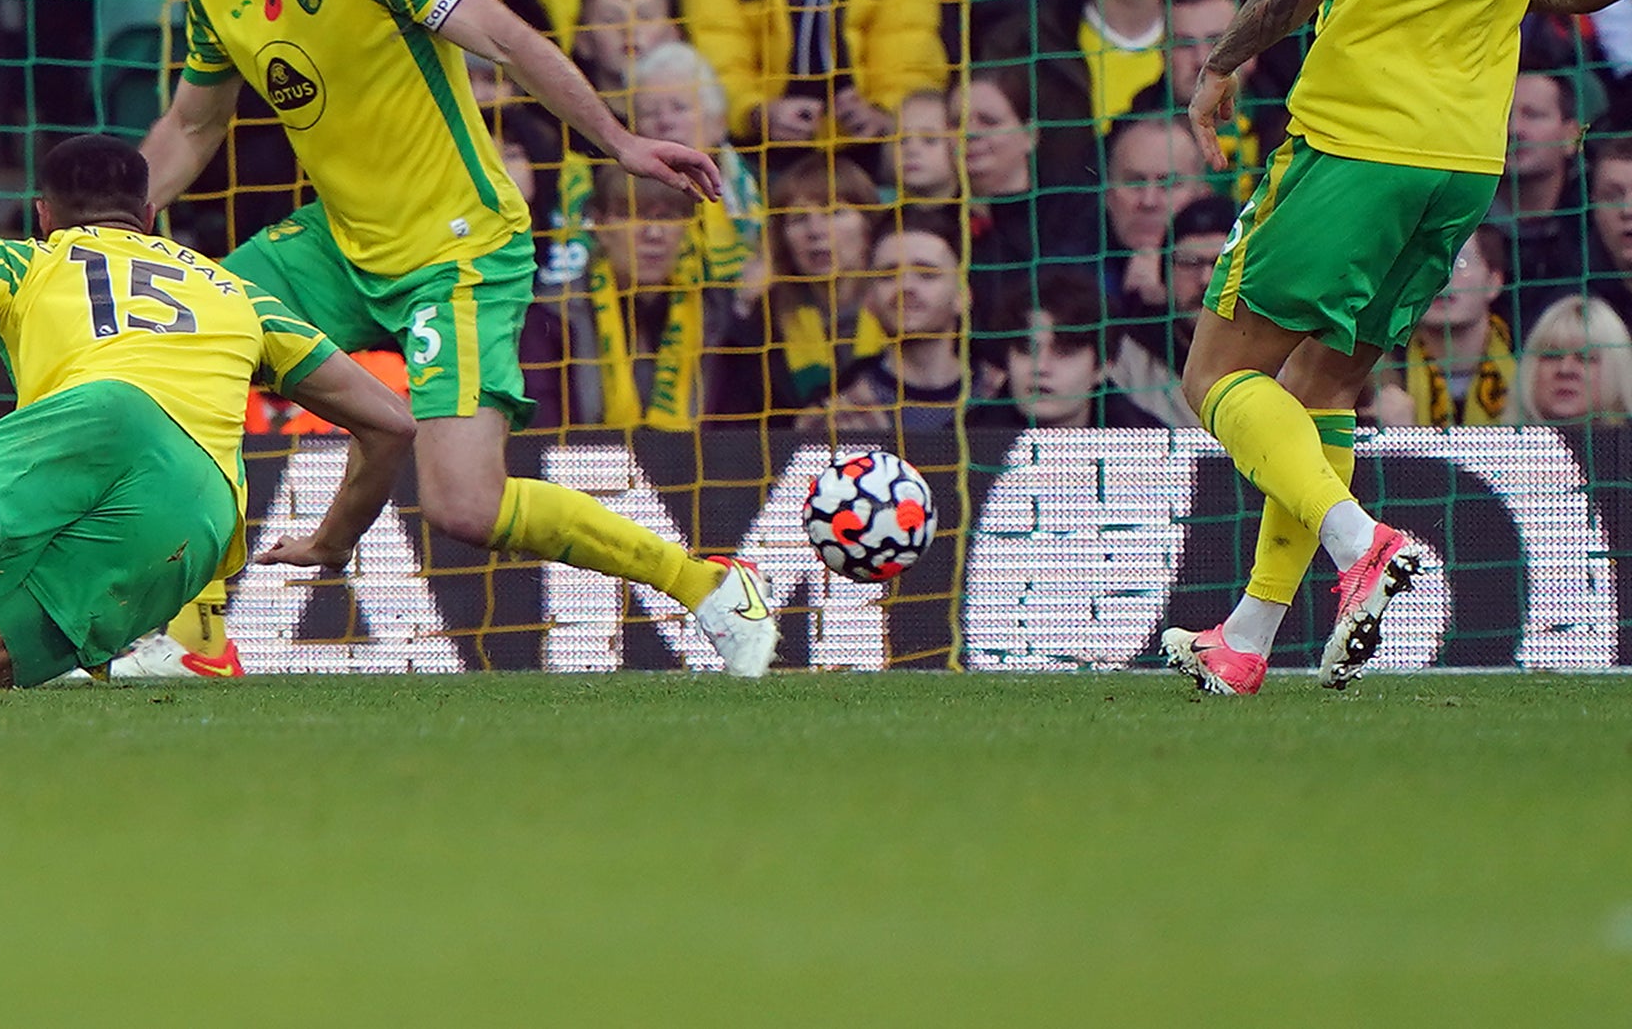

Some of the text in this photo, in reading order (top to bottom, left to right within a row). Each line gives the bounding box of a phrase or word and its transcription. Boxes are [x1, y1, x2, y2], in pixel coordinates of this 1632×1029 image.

[270, 81, 315, 104] LOTUS
[69, 245, 197, 339] 15
[412, 305, 442, 364] 5
